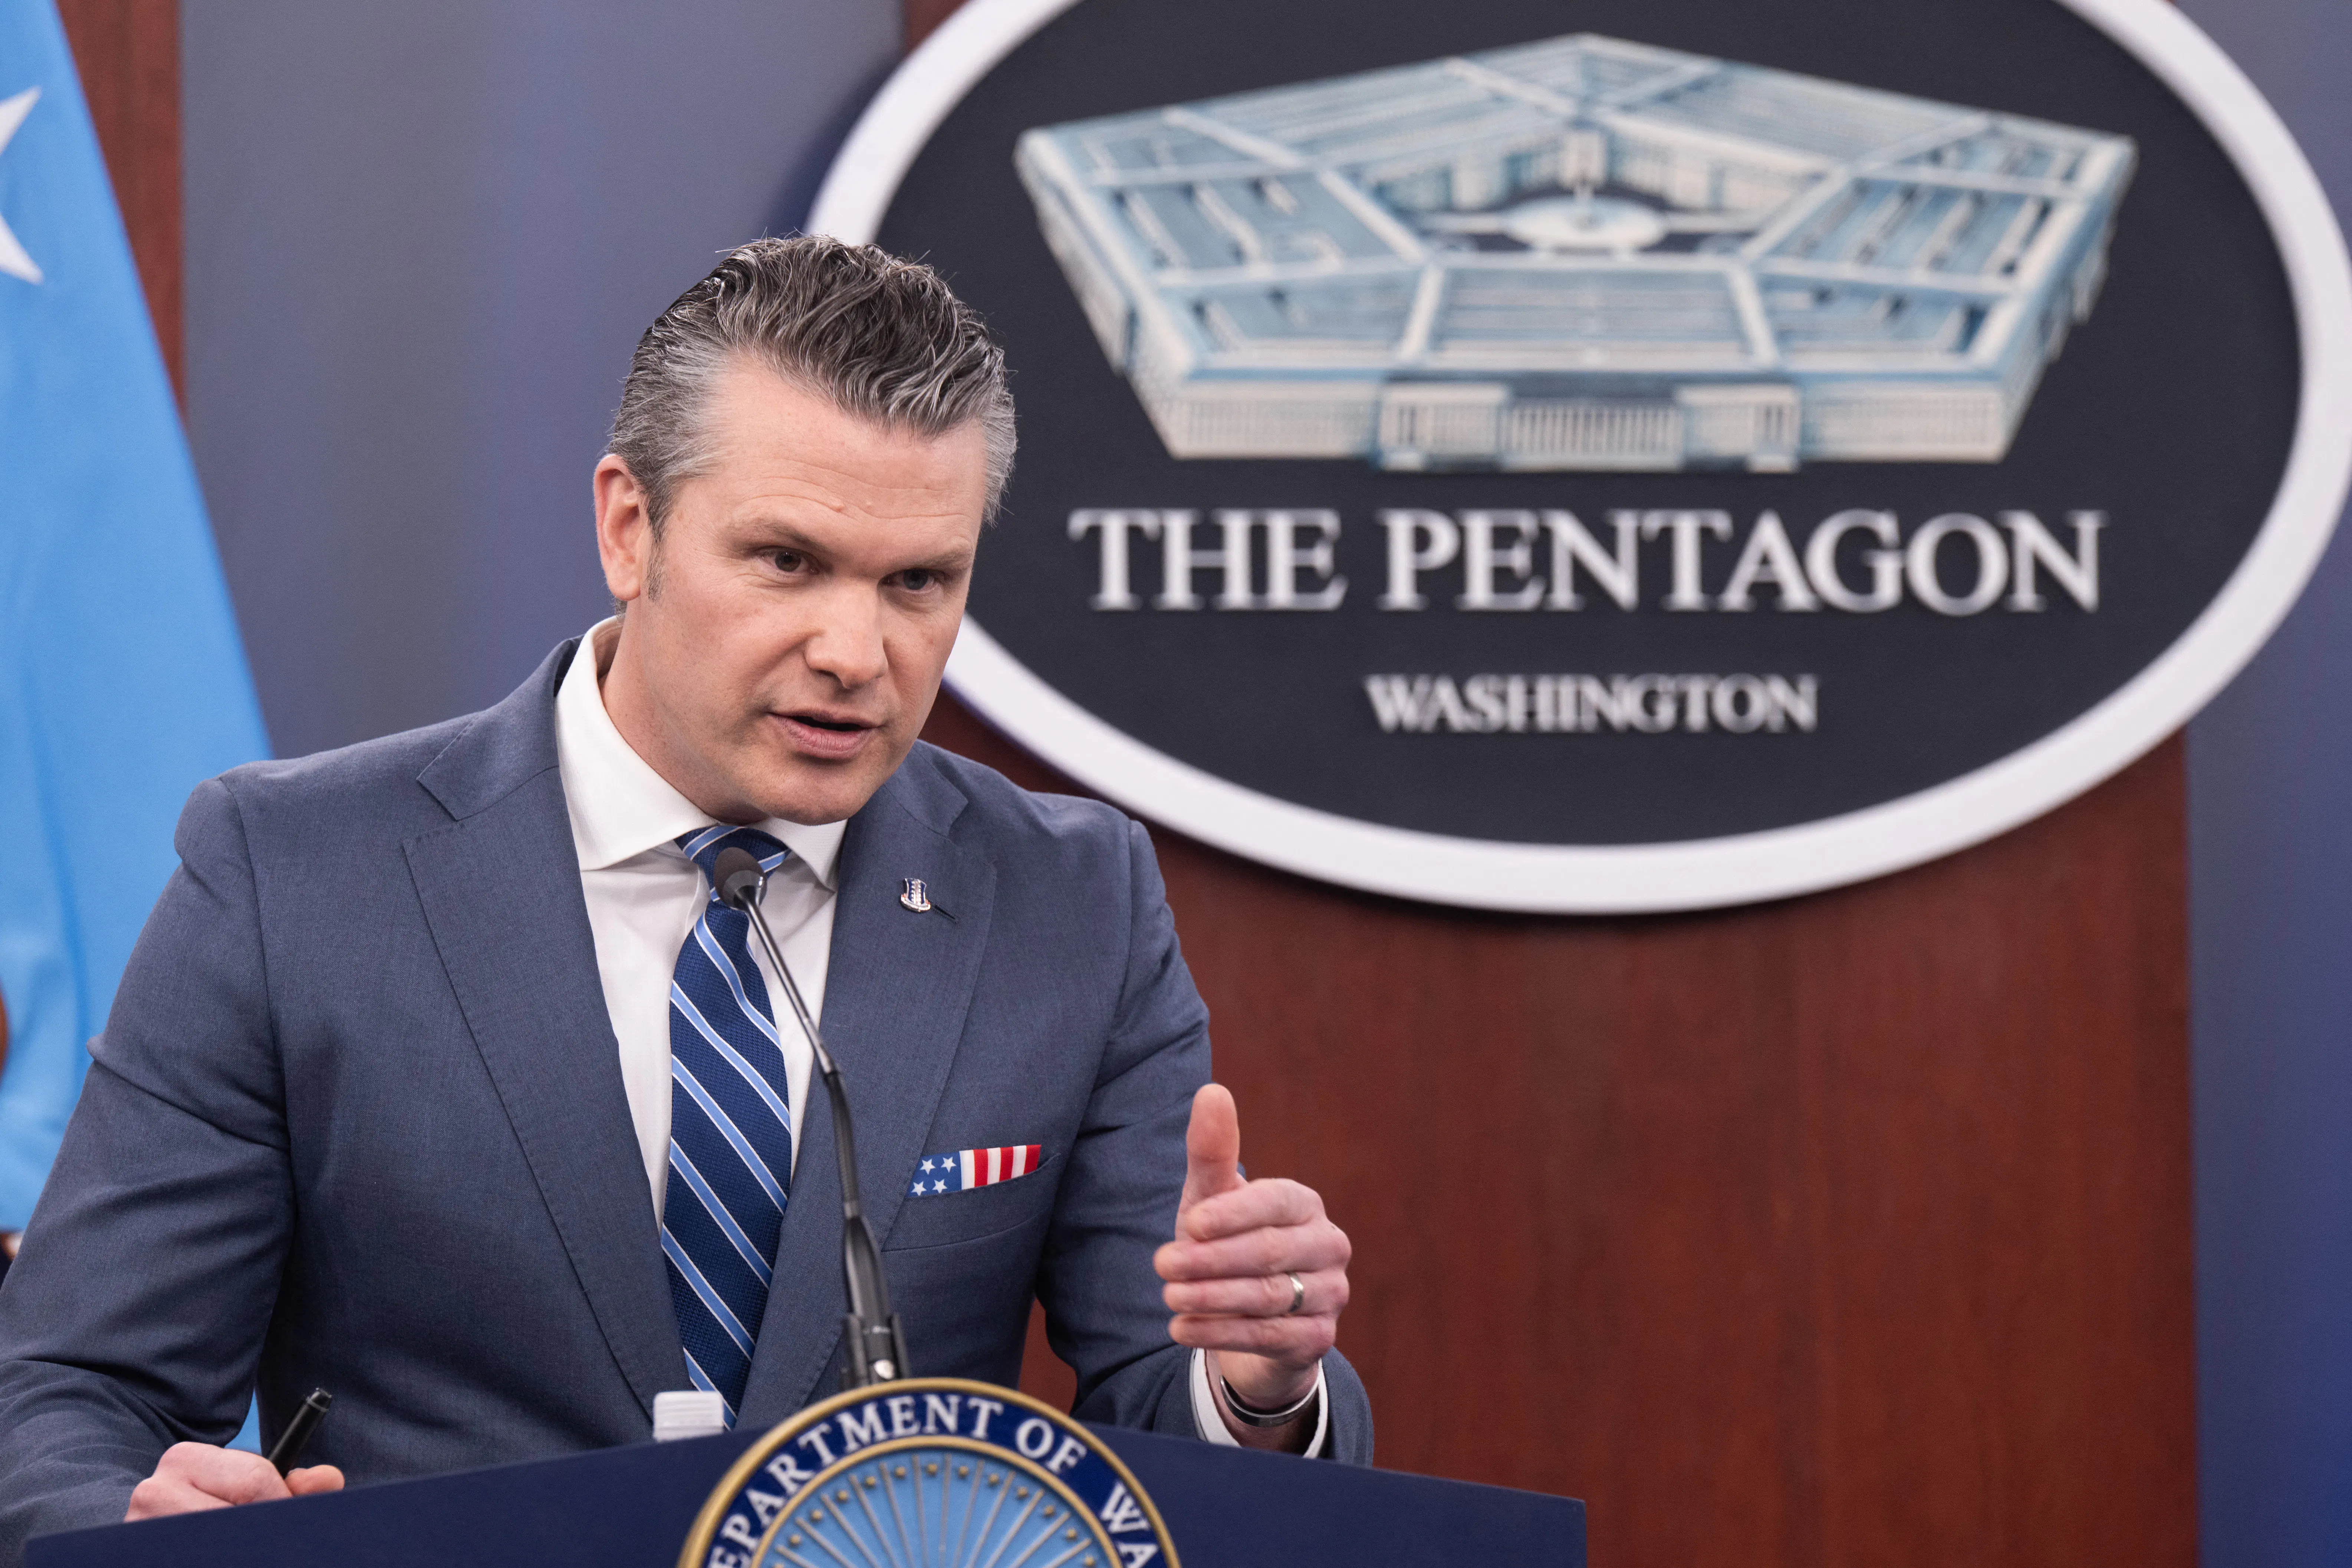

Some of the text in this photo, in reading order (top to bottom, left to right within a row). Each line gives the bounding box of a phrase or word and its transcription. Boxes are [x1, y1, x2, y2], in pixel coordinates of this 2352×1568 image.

[1068, 508, 2103, 615] THE PENTAGON
[1365, 674, 1818, 732] WASHINGTON
[1015, 1417, 1087, 1475] OF
